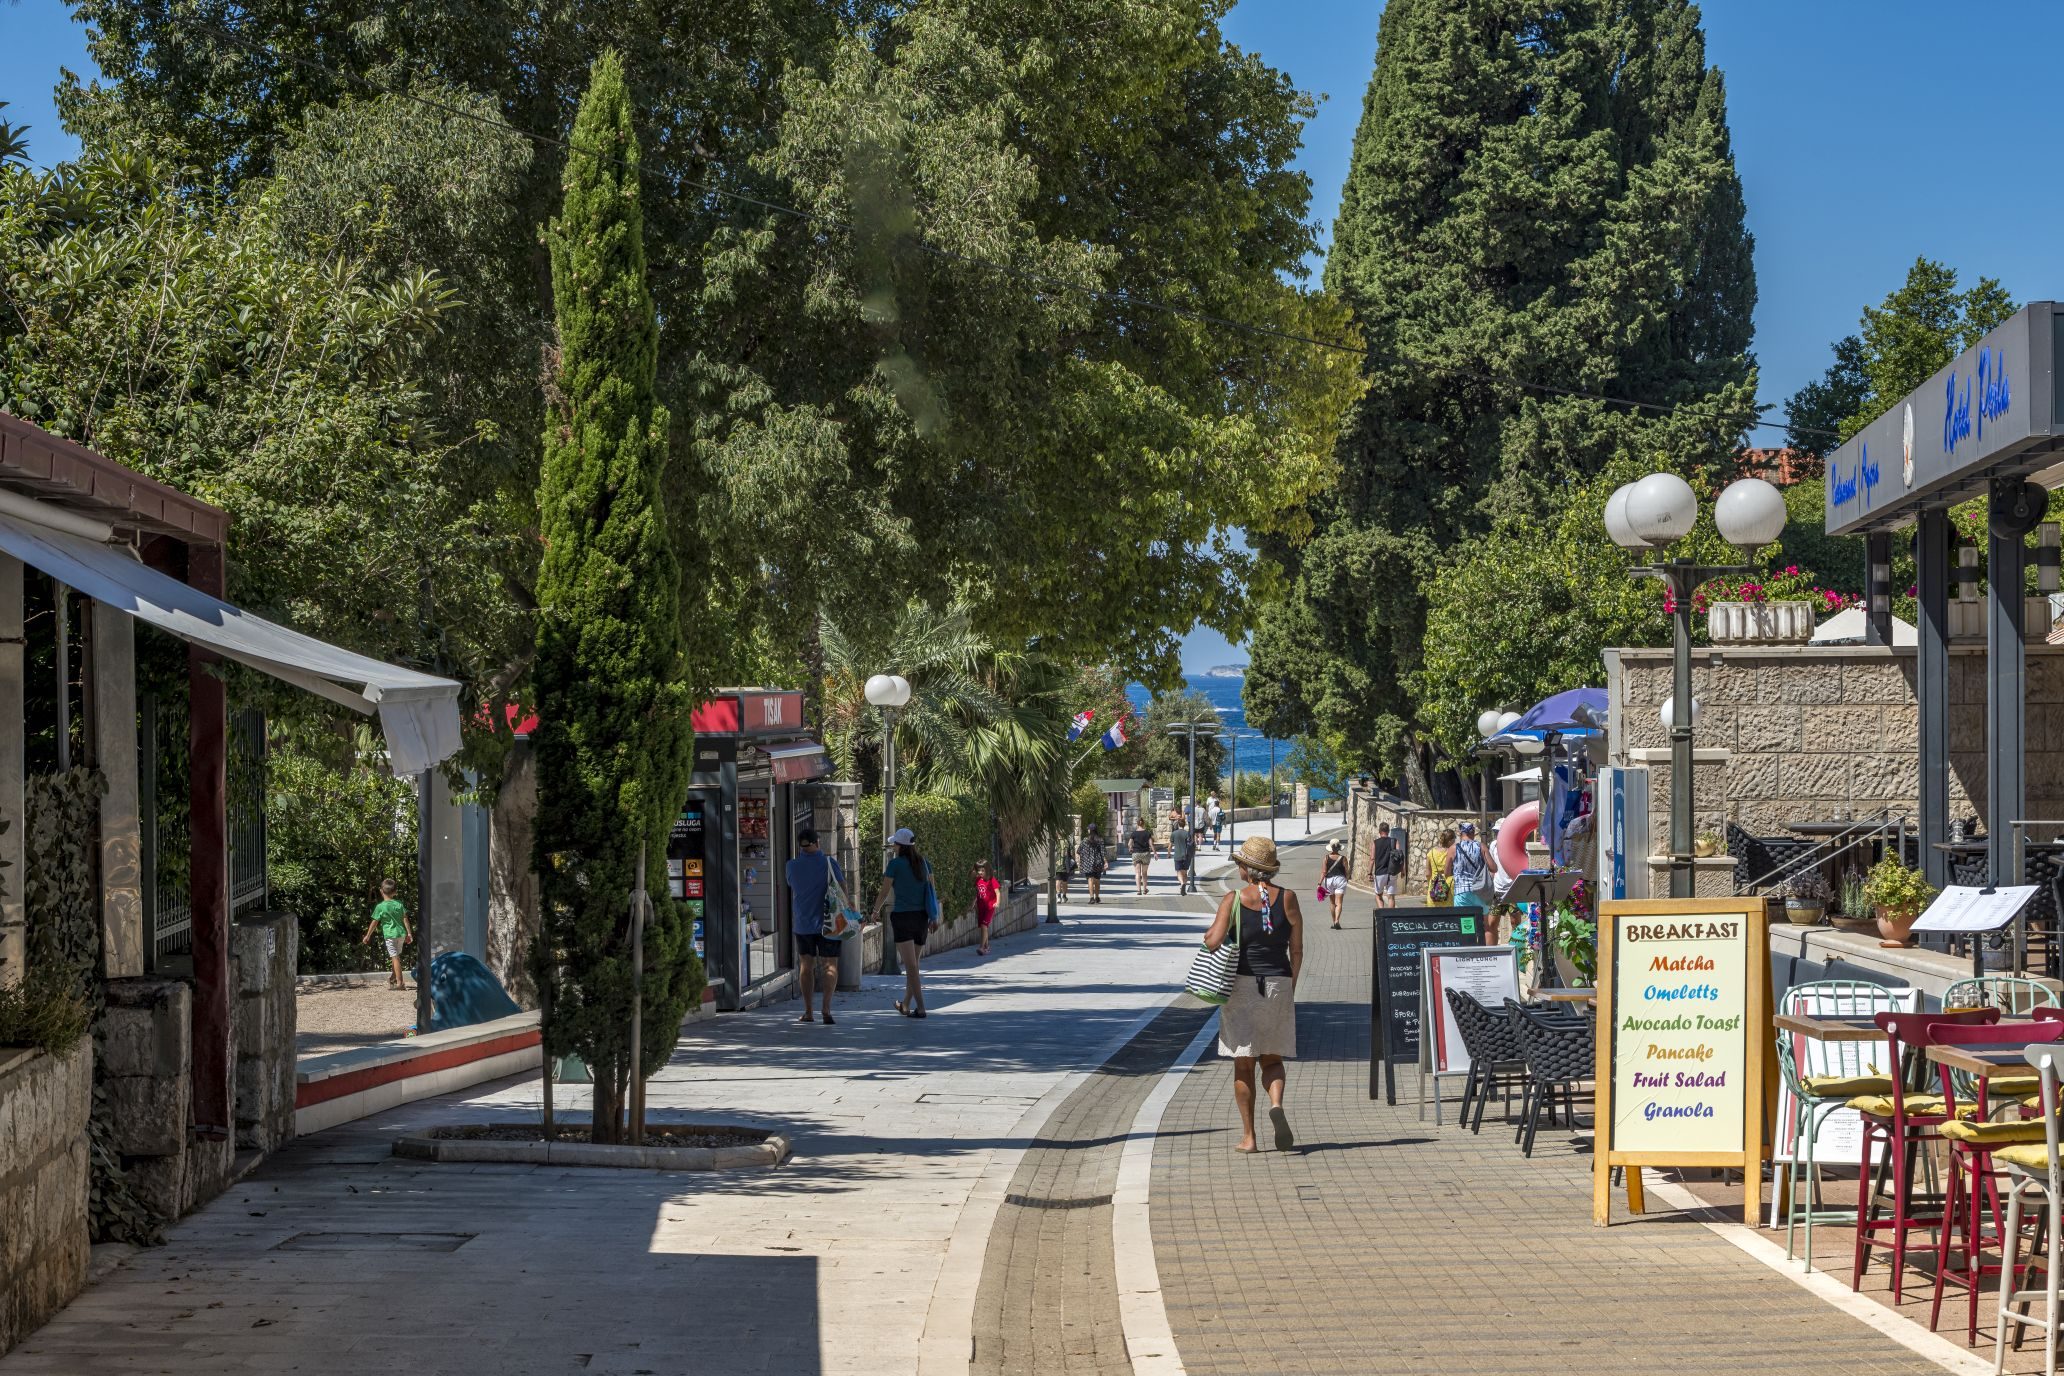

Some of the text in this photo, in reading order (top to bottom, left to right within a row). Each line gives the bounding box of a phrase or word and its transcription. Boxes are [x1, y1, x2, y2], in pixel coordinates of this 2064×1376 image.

[763, 697, 782, 726] TISAK
[1391, 922, 1428, 931] SPECIAL
[1626, 922, 1739, 942] BREAKFAST
[1648, 955, 1715, 971] Matcha
[1644, 984, 1719, 1001] Omeletts
[1622, 1014, 1740, 1031] Avocado Toast
[1646, 1043, 1714, 1062] Pancake
[1633, 1070, 1726, 1087] Fruit Salad
[1644, 1102, 1714, 1121] Granola
